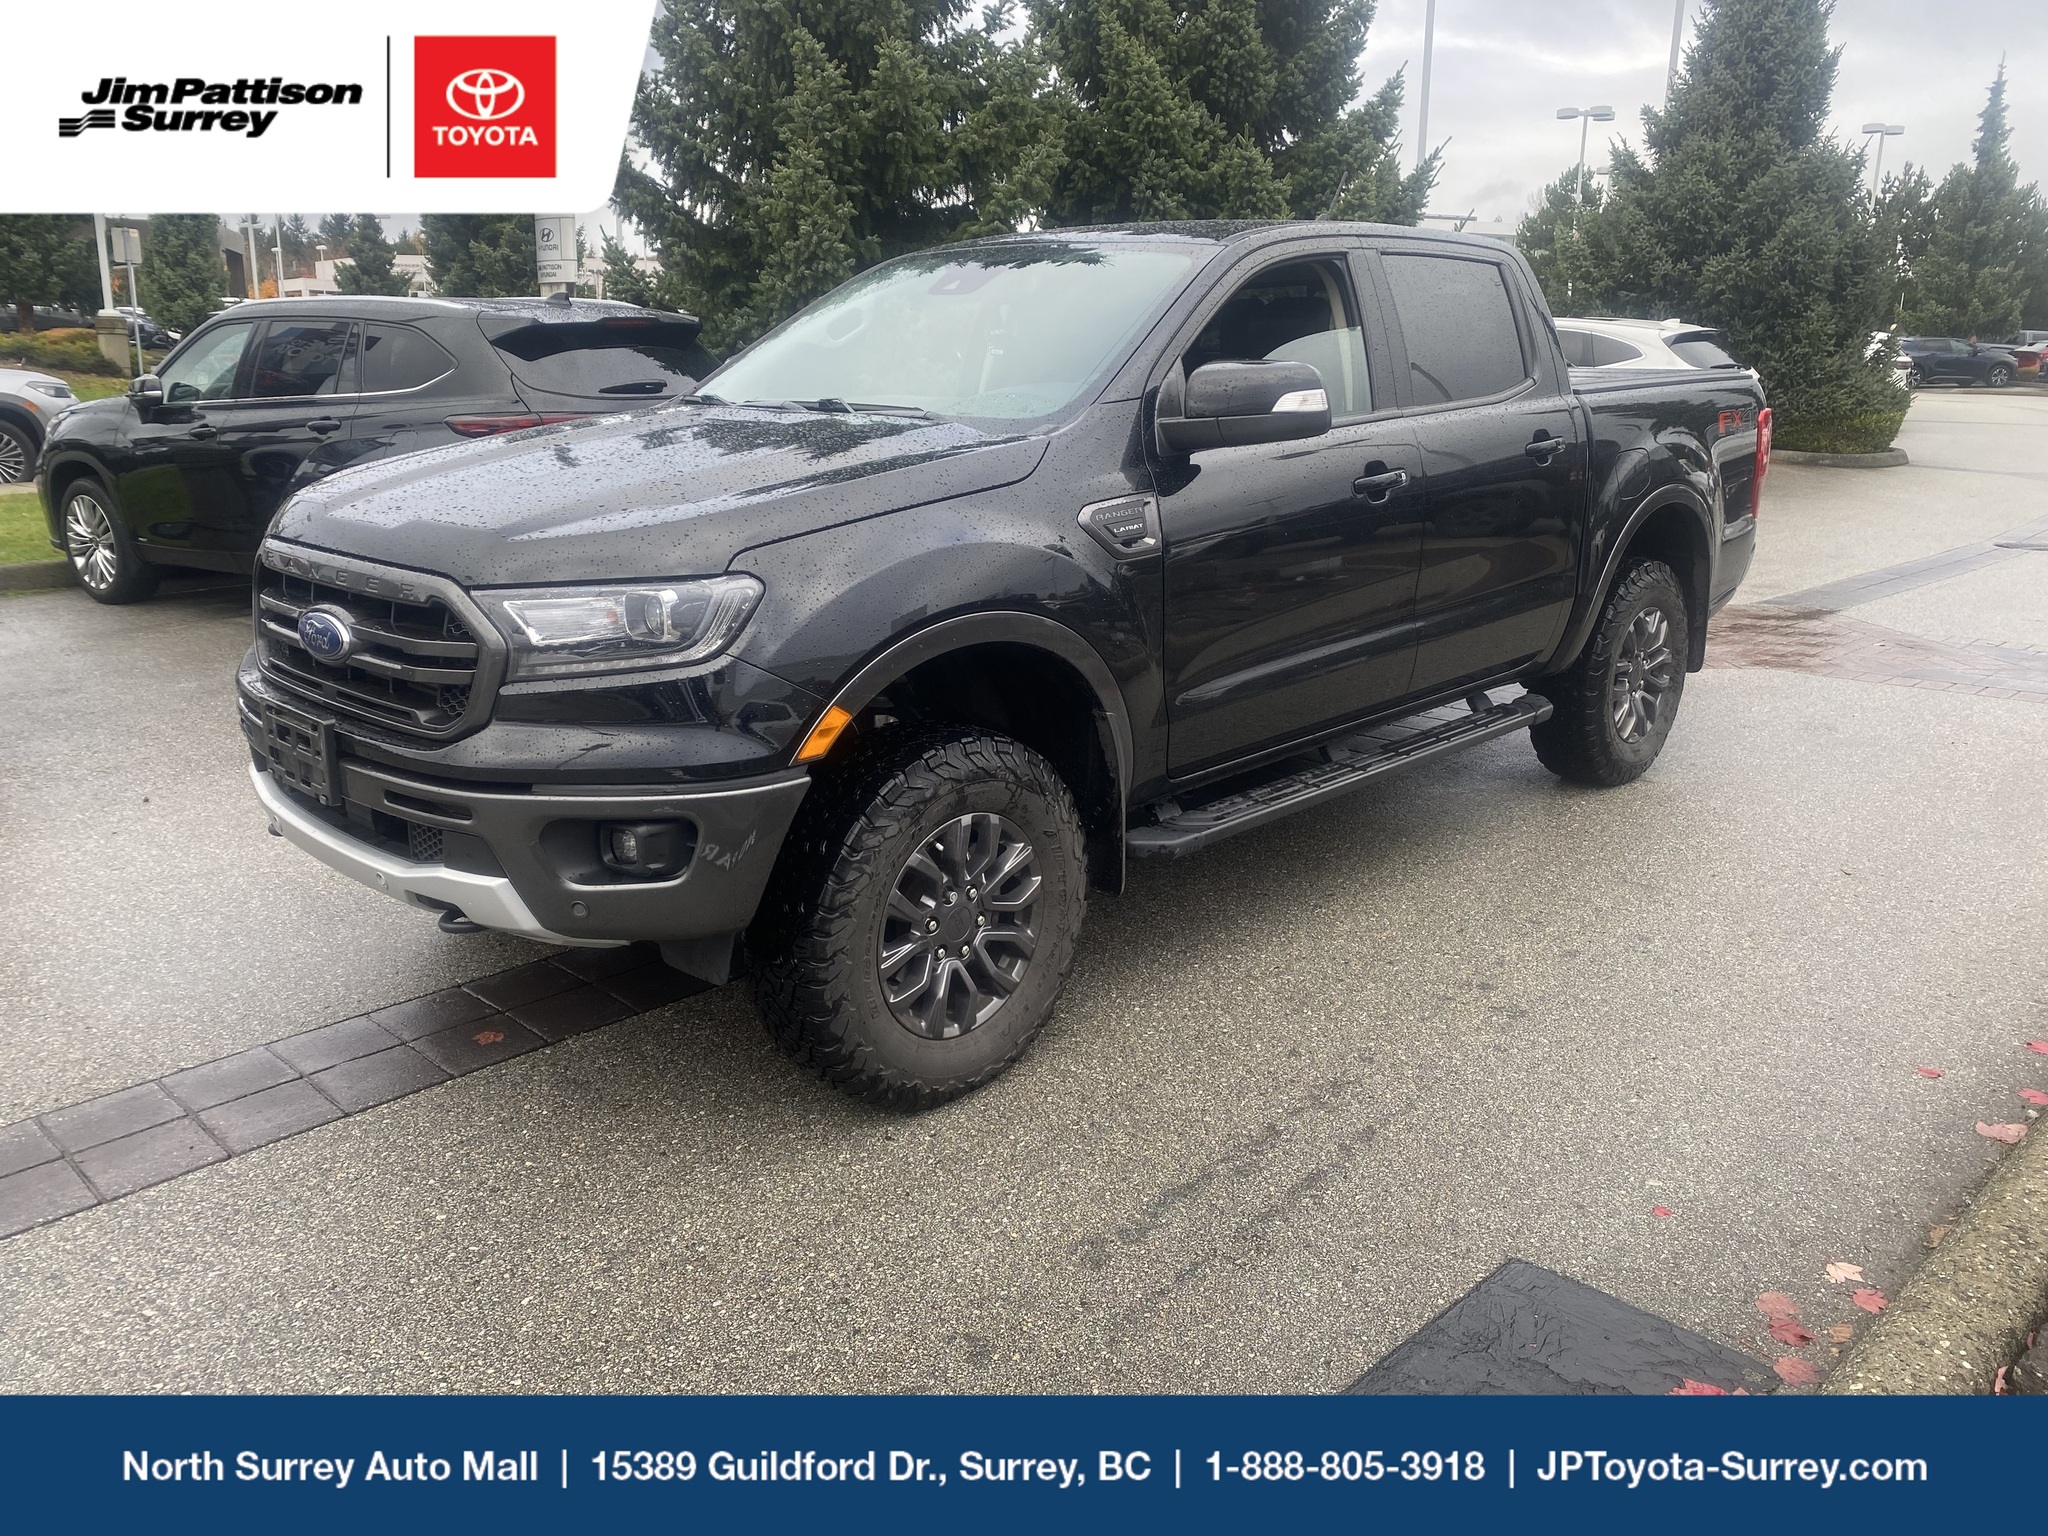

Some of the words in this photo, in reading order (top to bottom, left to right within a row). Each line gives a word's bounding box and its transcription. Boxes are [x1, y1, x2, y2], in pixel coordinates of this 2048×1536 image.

[1717, 407, 1758, 437] FX4
[1095, 506, 1143, 521] RANGER
[1113, 522, 1144, 533] LARIAT
[304, 619, 332, 650] Ford
